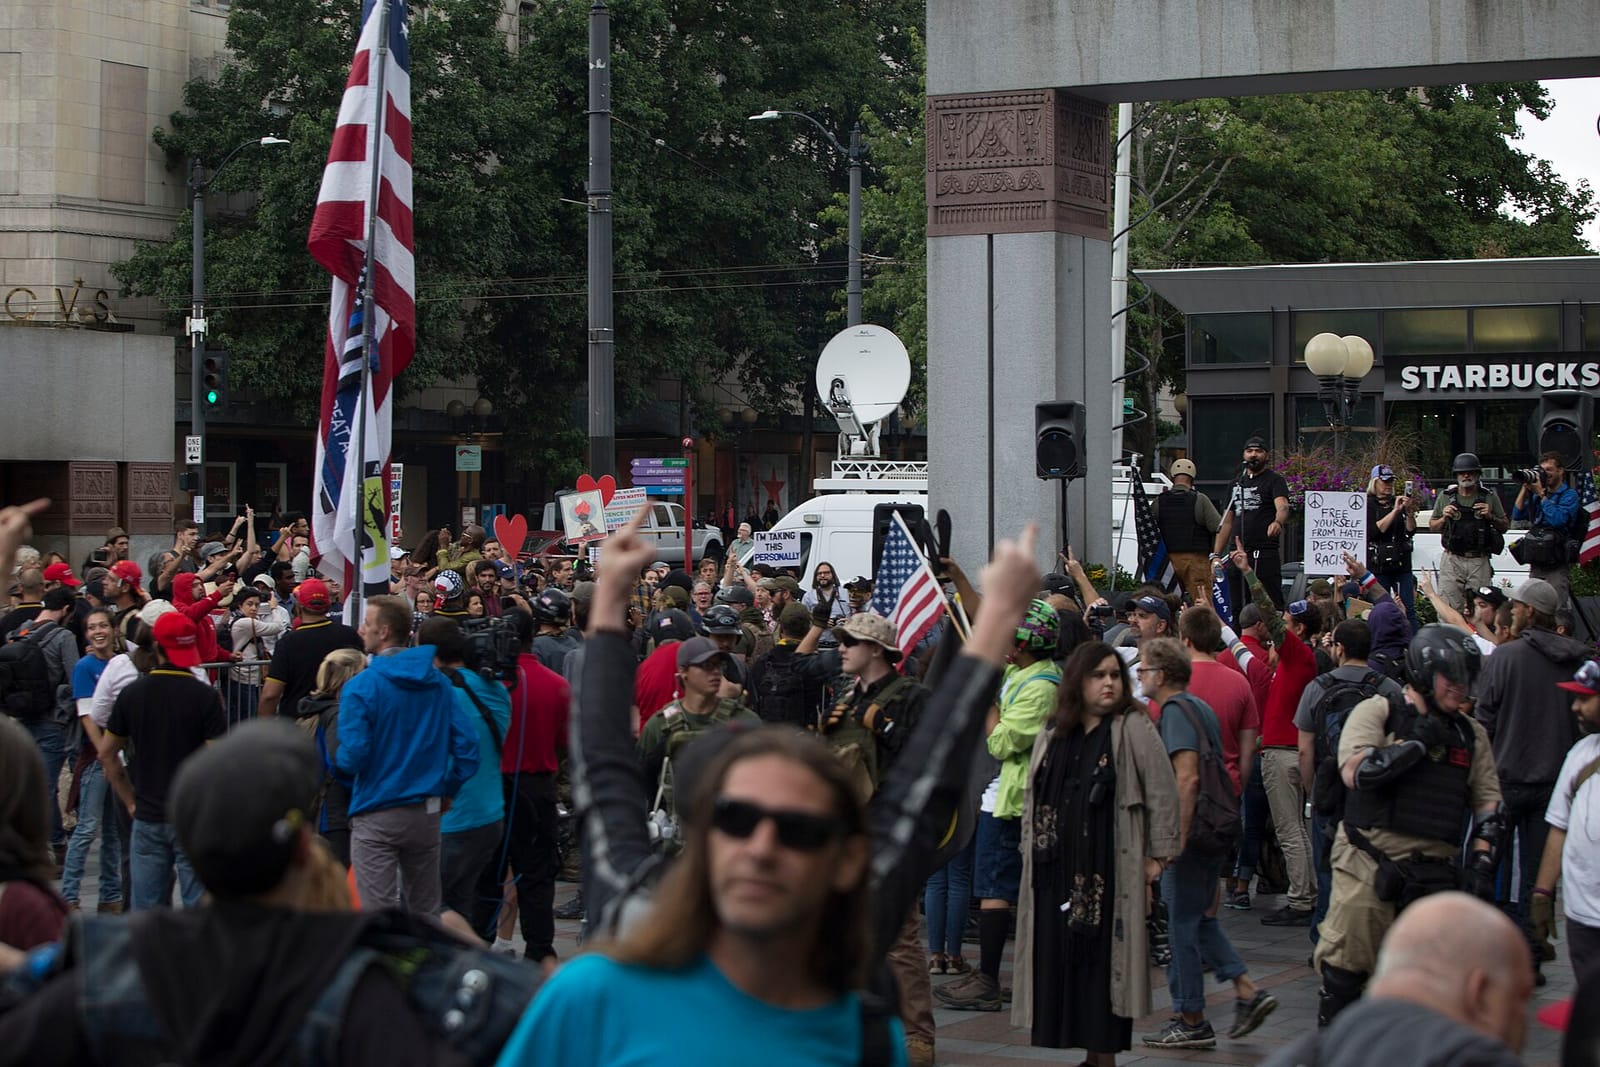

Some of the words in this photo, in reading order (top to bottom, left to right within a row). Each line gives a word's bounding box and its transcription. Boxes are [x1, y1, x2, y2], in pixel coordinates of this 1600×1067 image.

[1401, 362, 1600, 390] STARBUCKS
[187, 438, 200, 446] ONE
[214, 488, 228, 497] SALE
[264, 488, 278, 497] SALE
[1321, 507, 1348, 519] FREE
[1314, 519, 1362, 528] YOURSELF
[769, 531, 796, 541] TAKING
[1311, 528, 1336, 537] FROM
[1340, 529, 1364, 538] HATE
[765, 542, 783, 551] THIS
[1312, 540, 1358, 551] DESTROY
[754, 552, 800, 562] PERSONALLY
[1314, 552, 1358, 567] RACIS
[1212, 583, 1225, 604] The
